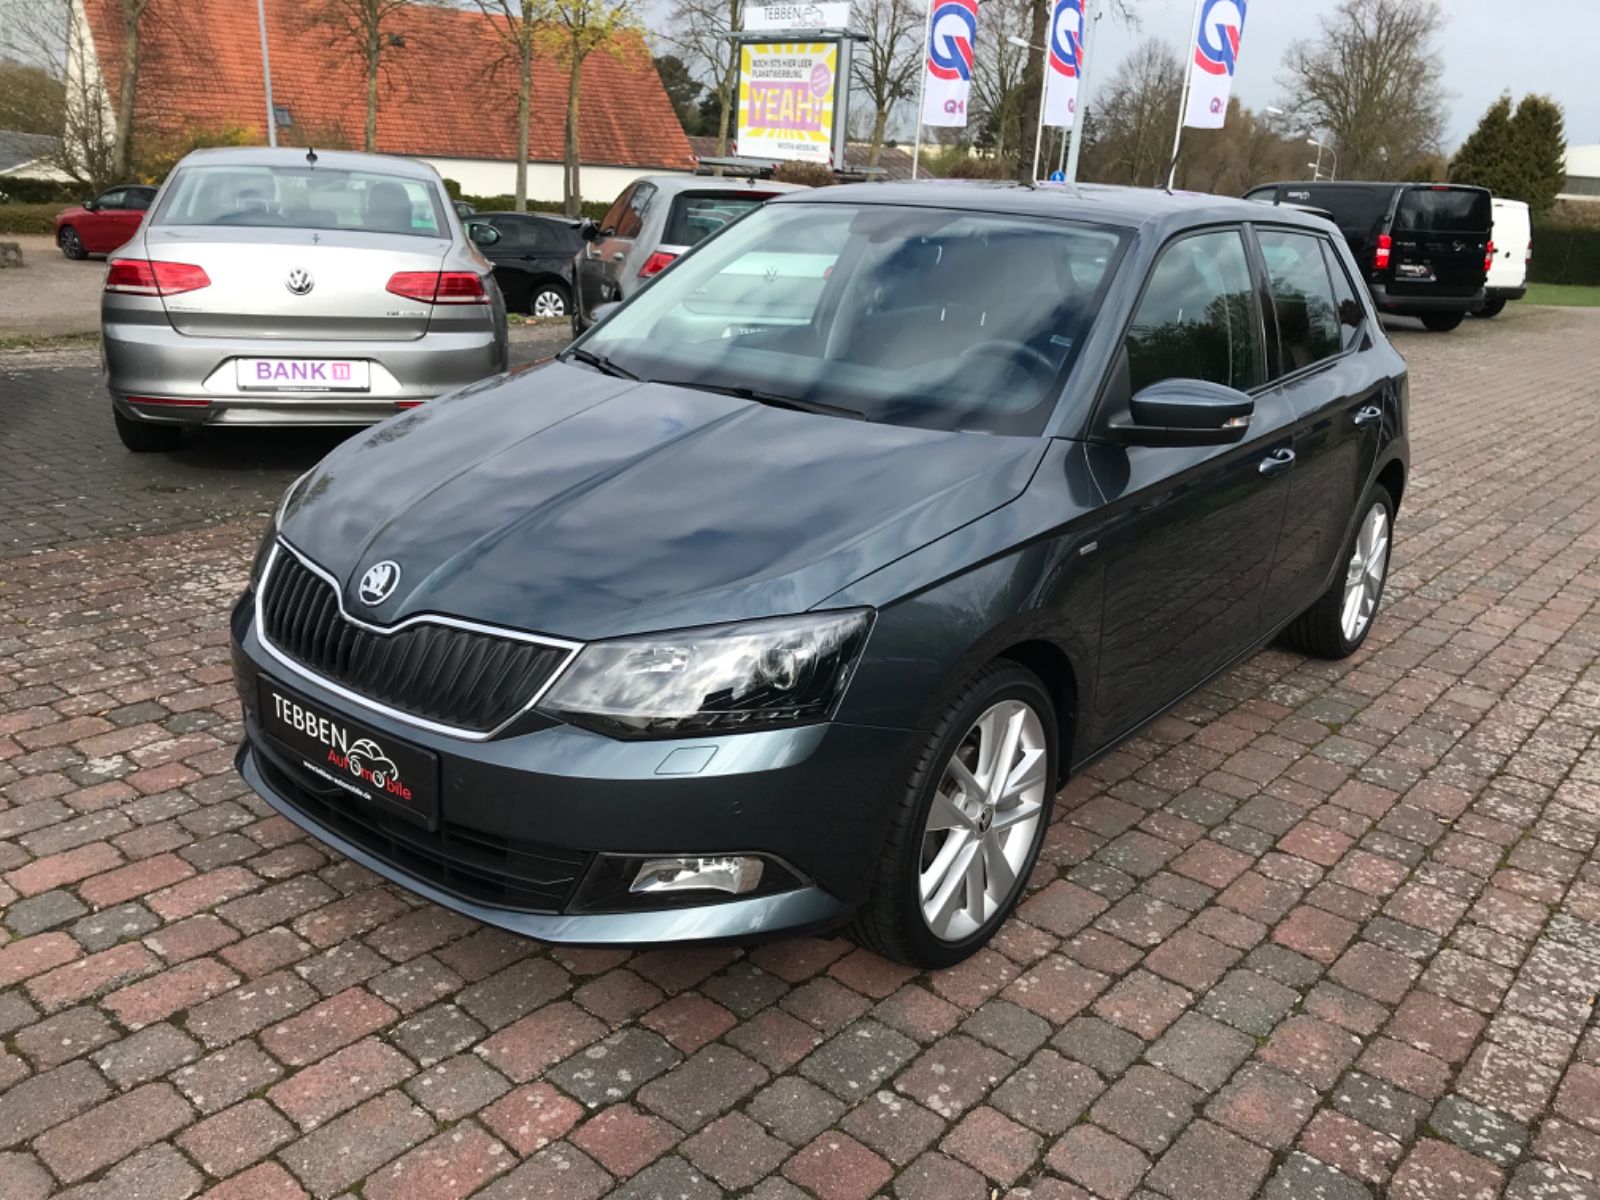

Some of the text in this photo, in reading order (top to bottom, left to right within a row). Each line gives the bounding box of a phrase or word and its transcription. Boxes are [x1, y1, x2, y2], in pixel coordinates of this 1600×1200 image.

[764, 6, 801, 20] TEBBEN
[751, 88, 821, 123] YEAH!
[944, 98, 964, 114] Q1
[256, 361, 327, 380] BANK
[272, 692, 347, 753] TEBBEN
